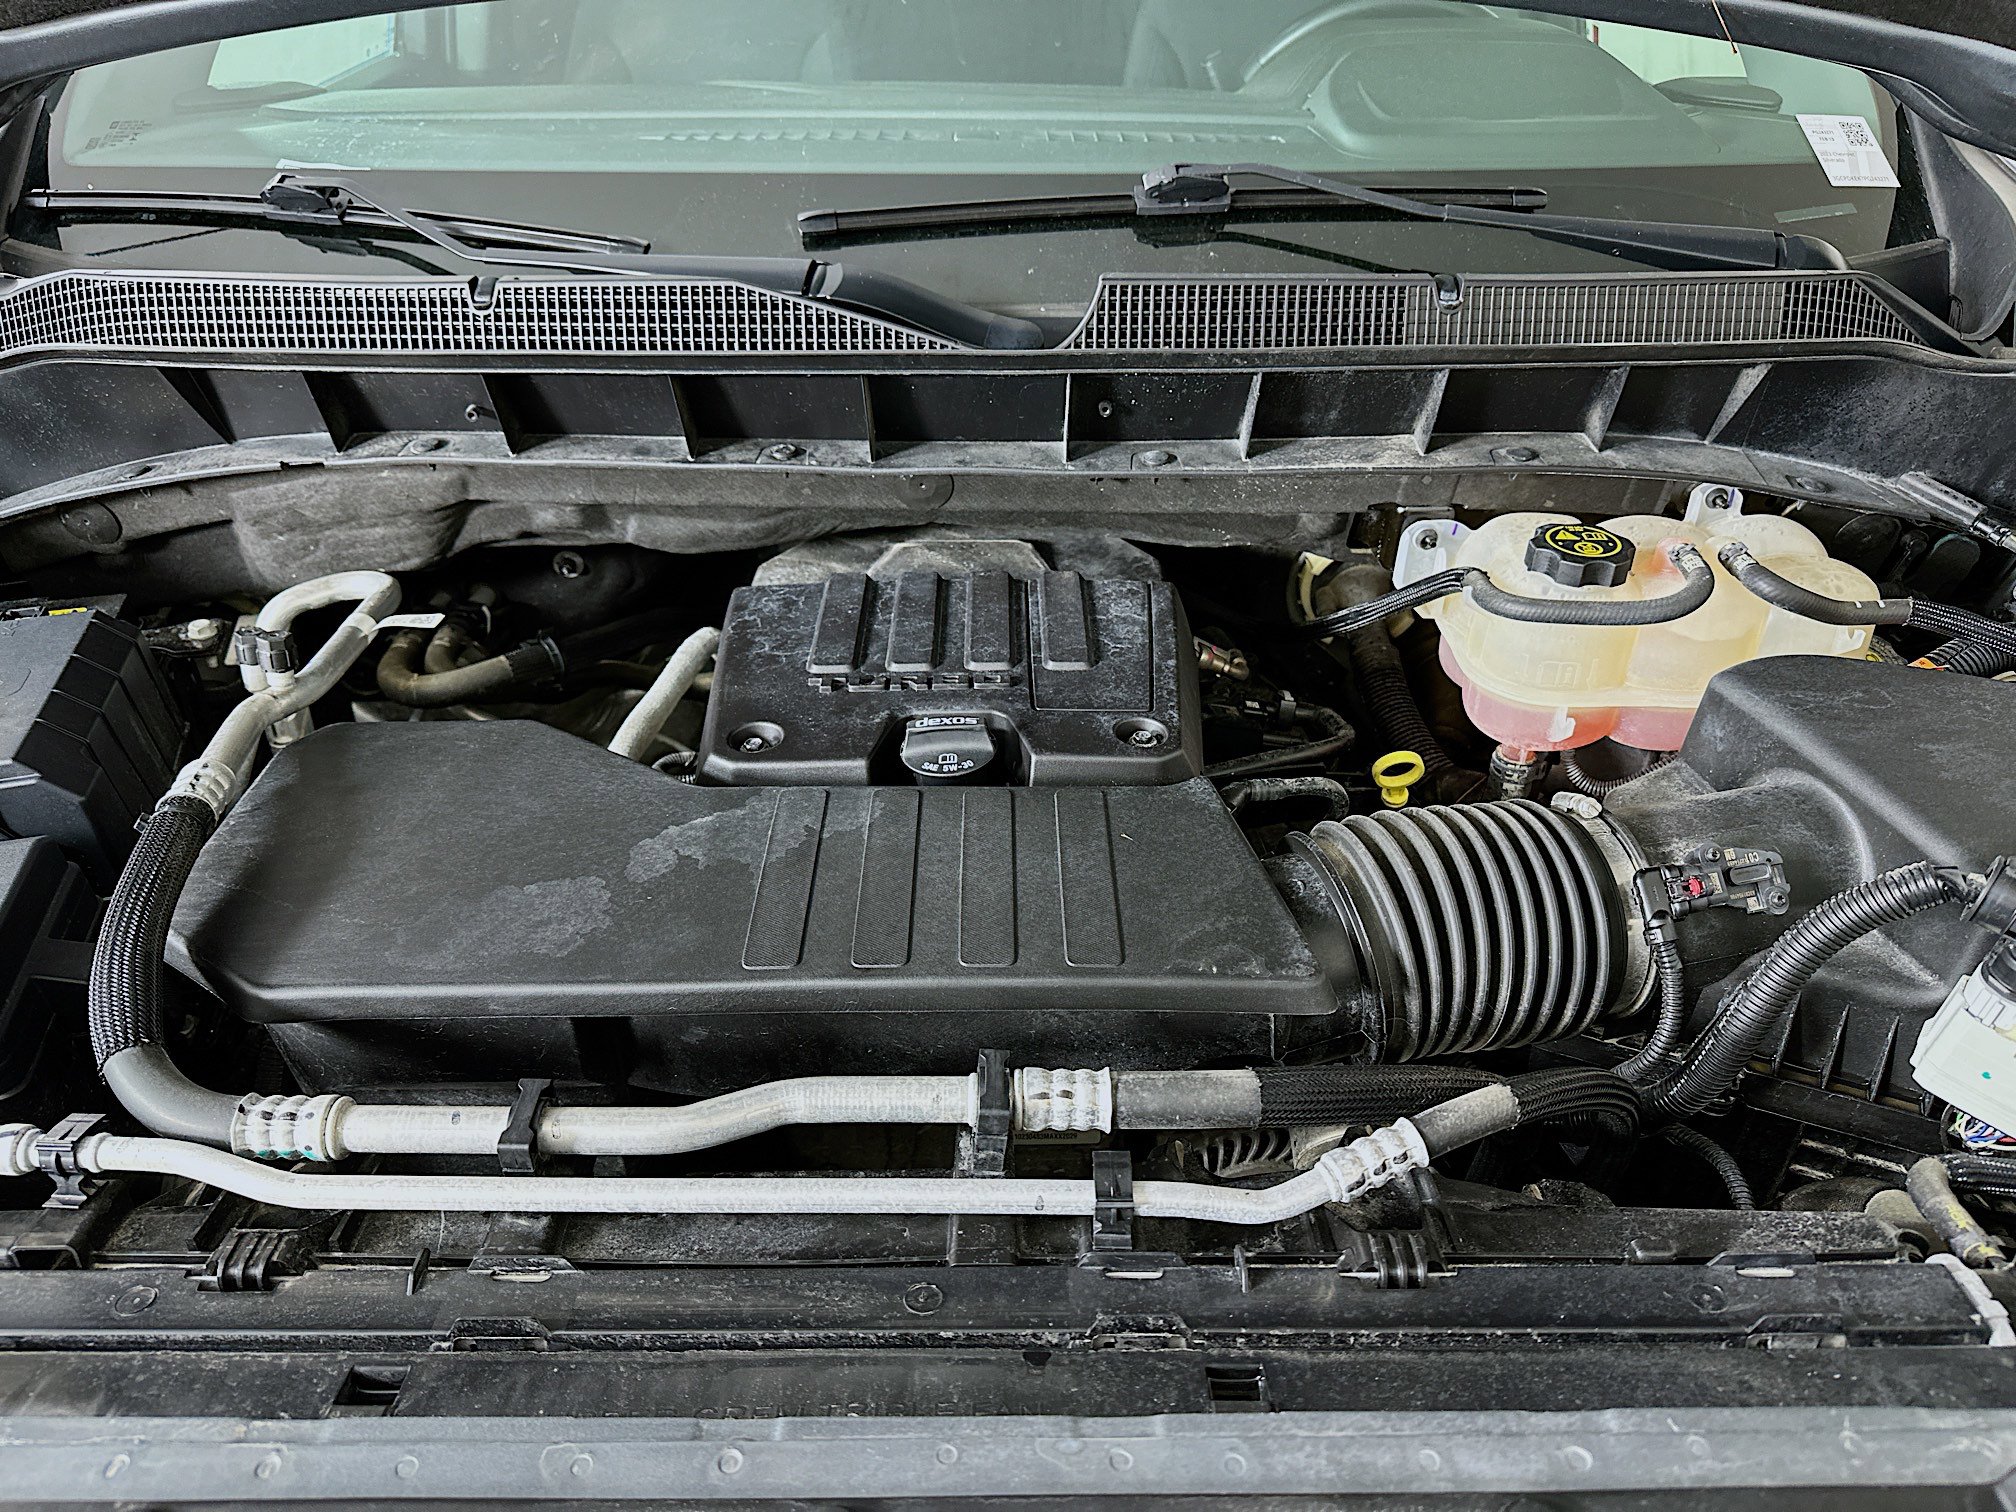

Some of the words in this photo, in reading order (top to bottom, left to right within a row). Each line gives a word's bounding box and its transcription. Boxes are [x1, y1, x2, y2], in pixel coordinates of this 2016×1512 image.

[915, 716, 980, 728] dexos
[921, 761, 940, 772] SAE
[942, 759, 975, 772] 5W-30
